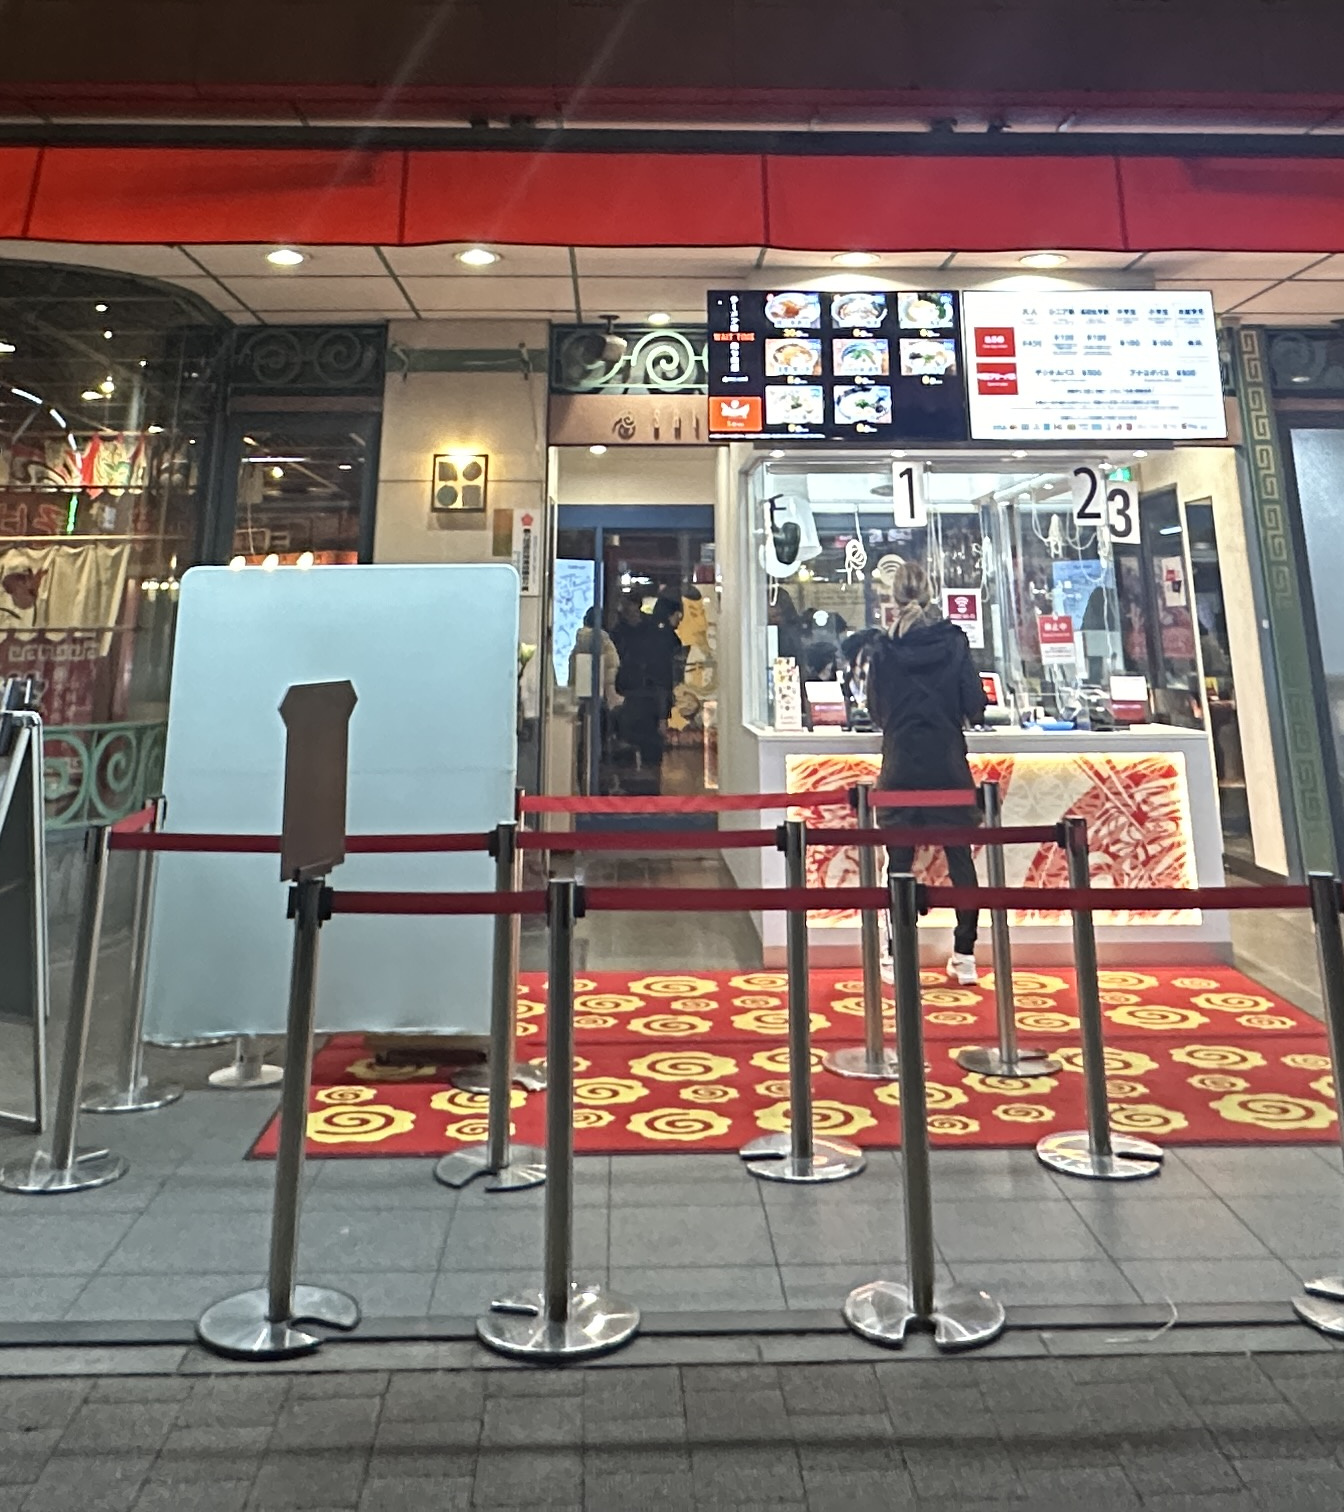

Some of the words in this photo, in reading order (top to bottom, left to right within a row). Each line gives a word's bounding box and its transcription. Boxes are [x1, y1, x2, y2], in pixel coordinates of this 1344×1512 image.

[899, 467, 915, 519] 1
[1073, 467, 1101, 519] 2
[1106, 488, 1132, 538] 3
